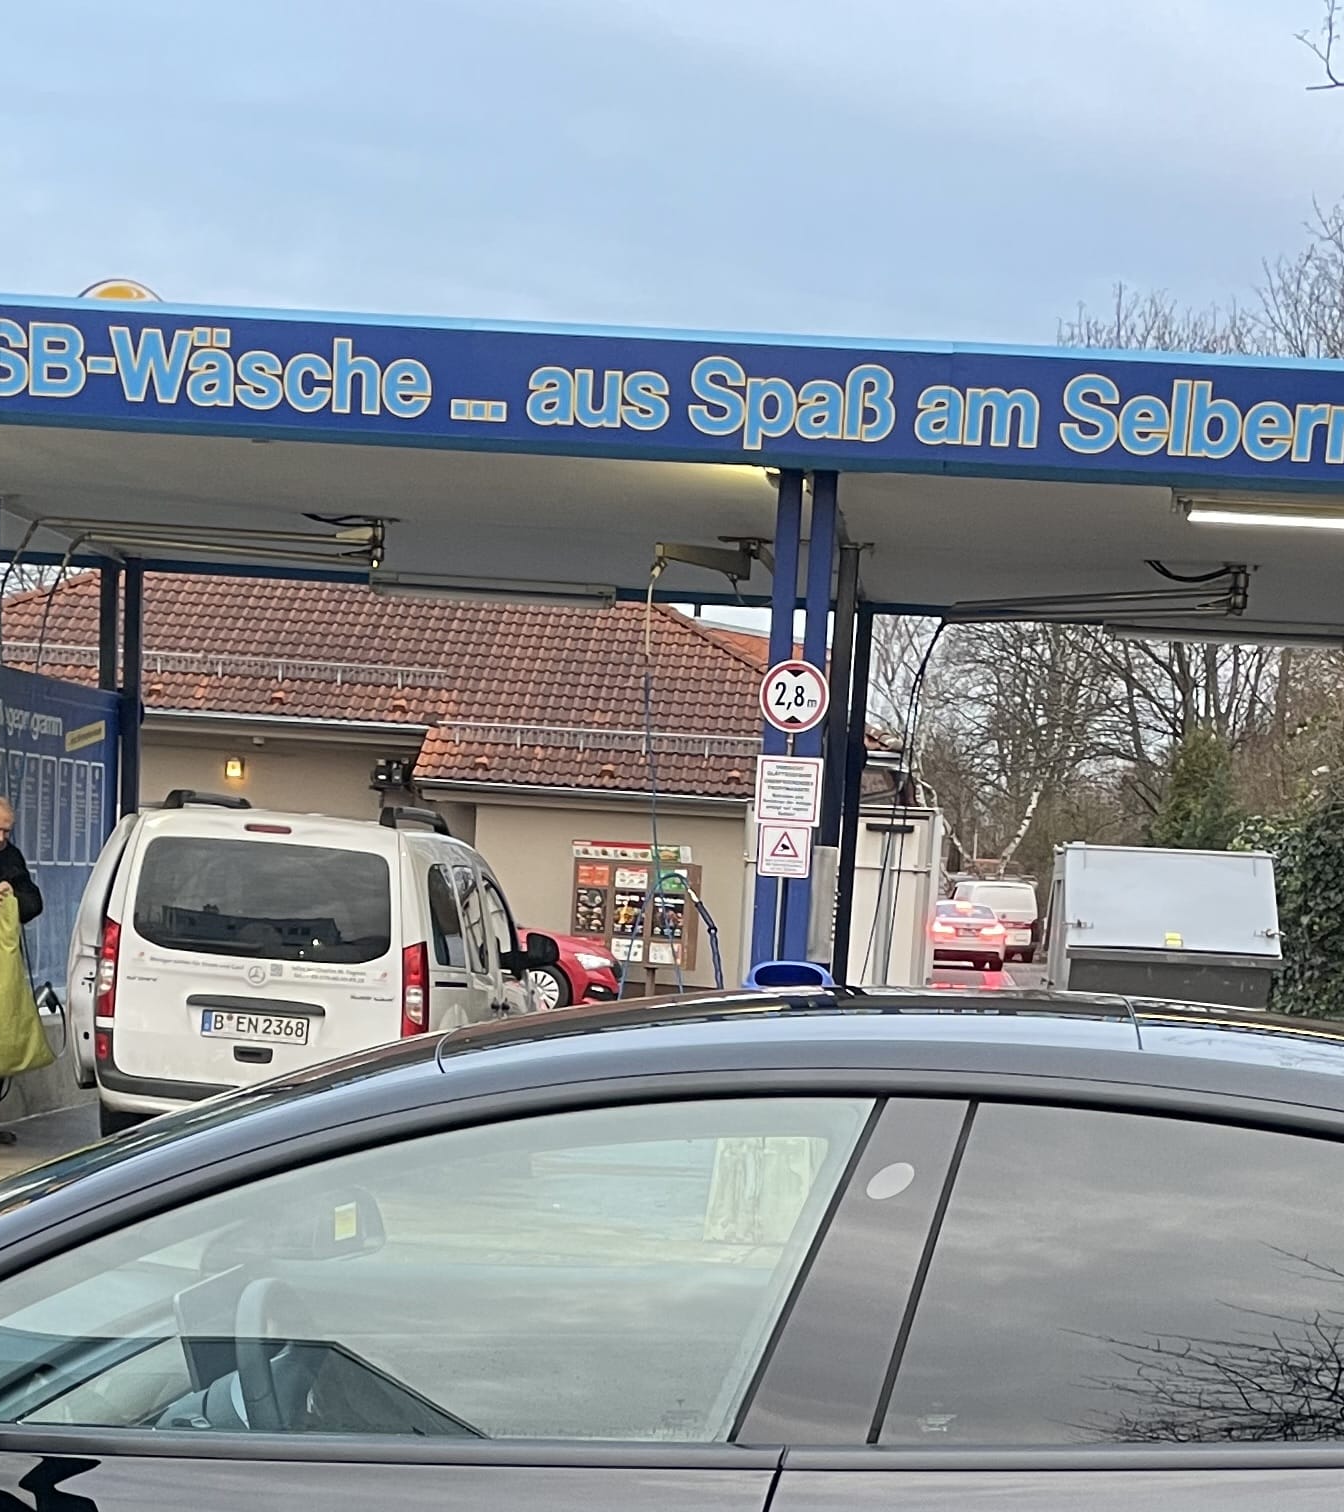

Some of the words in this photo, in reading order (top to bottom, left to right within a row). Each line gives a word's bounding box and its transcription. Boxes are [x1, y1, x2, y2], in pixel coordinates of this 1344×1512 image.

[526, 366, 670, 431] aus
[687, 355, 896, 450] Spaß
[914, 385, 1040, 449] am
[774, 681, 805, 711] 2,8
[213, 1013, 225, 1031] B
[236, 1015, 259, 1034] EN
[262, 1018, 306, 1039] 2368
